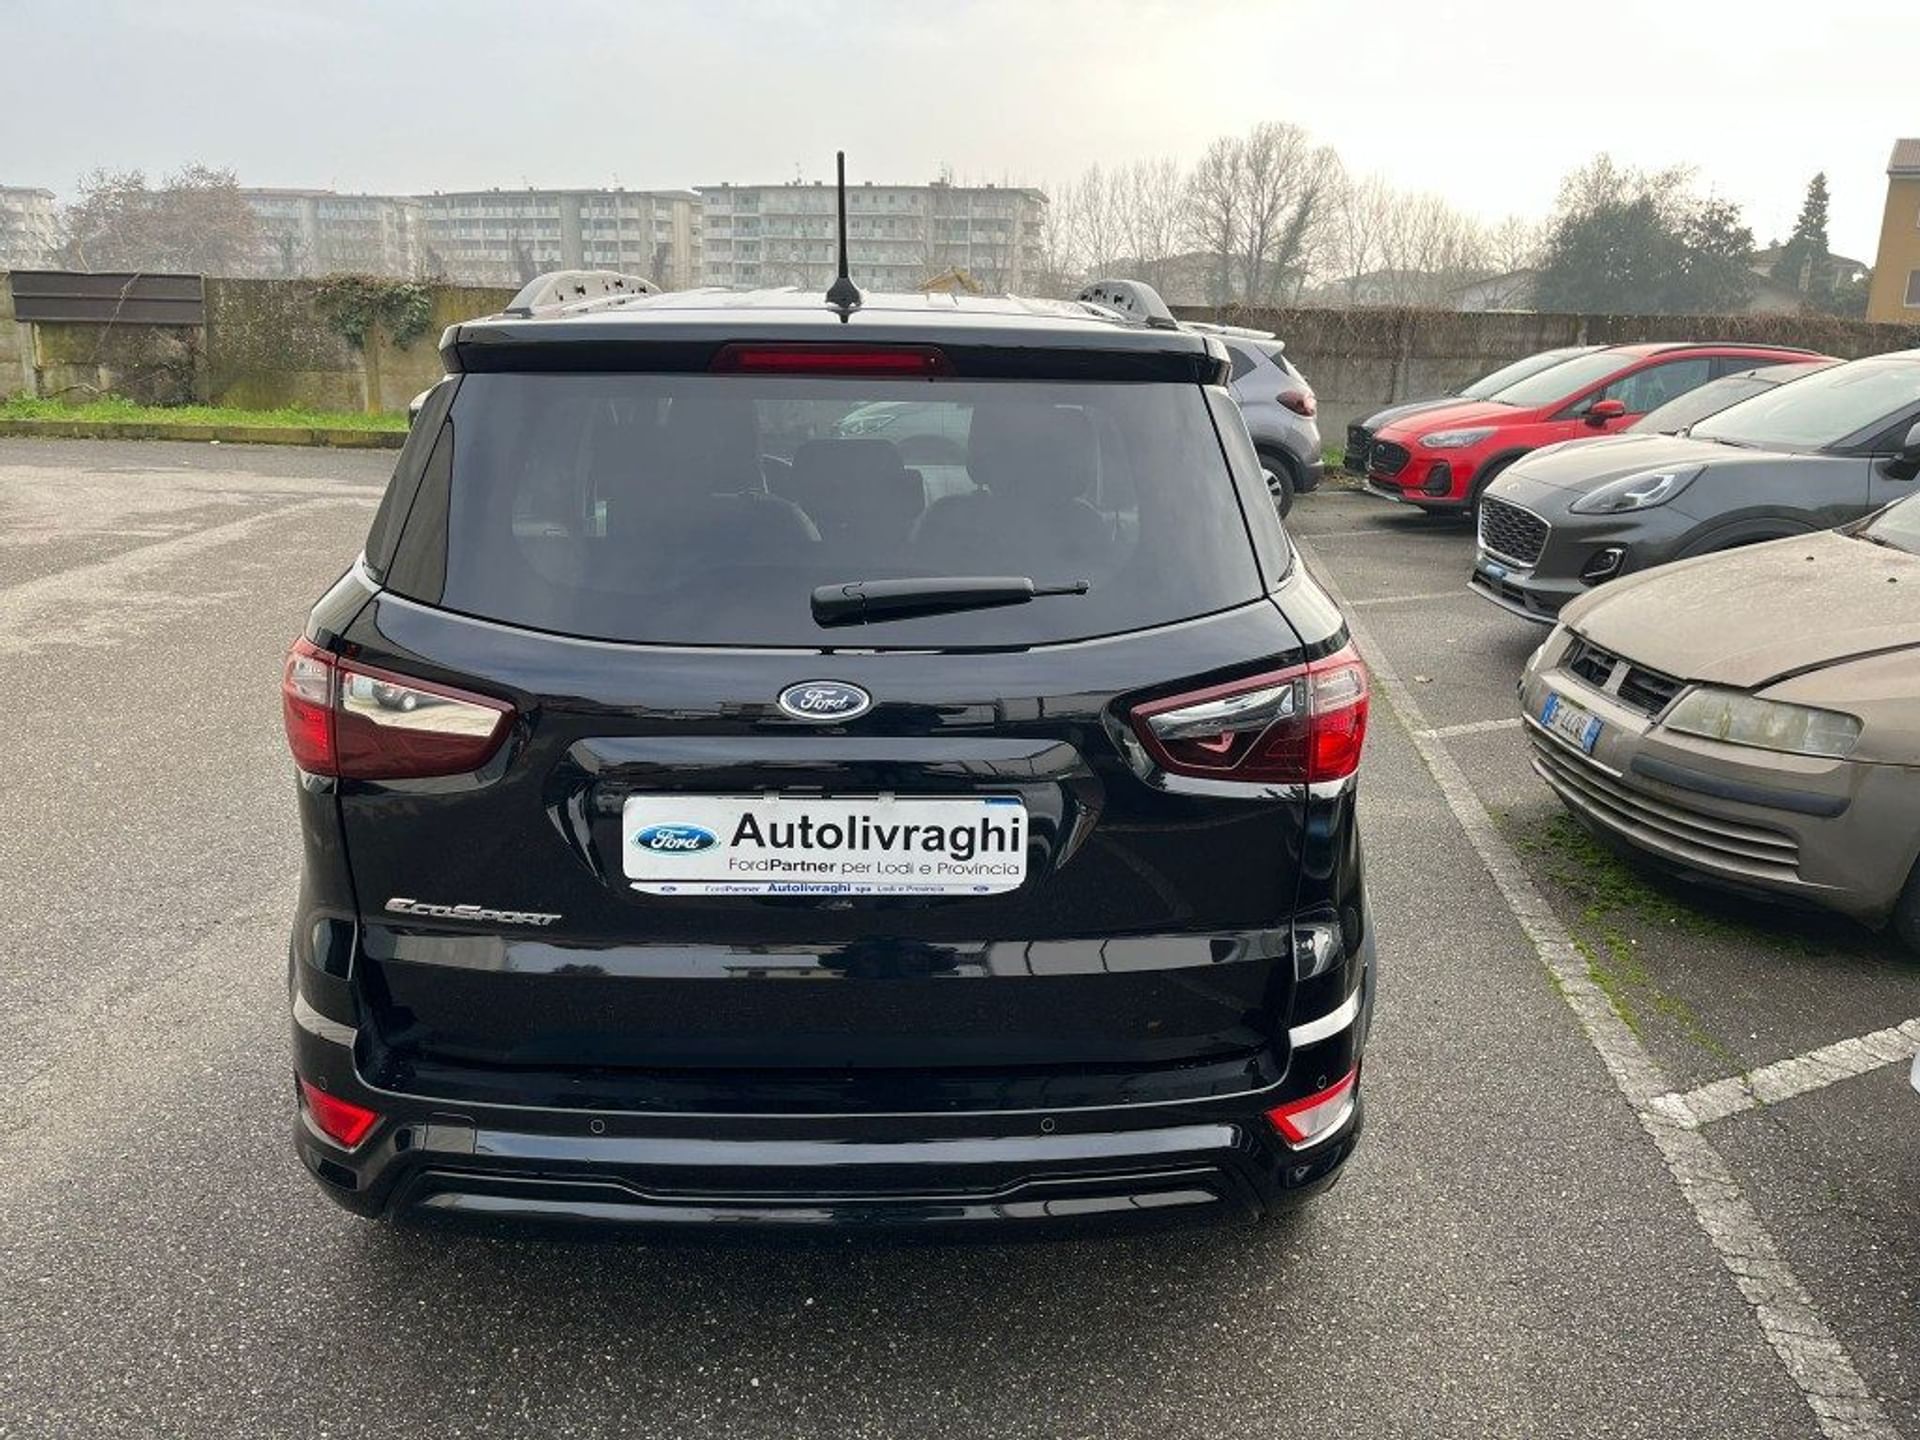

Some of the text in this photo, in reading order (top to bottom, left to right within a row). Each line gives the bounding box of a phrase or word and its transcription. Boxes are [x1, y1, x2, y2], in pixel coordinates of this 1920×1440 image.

[801, 689, 849, 710] Ford
[650, 828, 700, 850] Ford
[730, 812, 1020, 862] Autolivraghi
[729, 857, 1021, 876] FordPartner per Lodi e Provincia
[767, 882, 851, 895] Autolivraghi
[855, 885, 872, 894] spa
